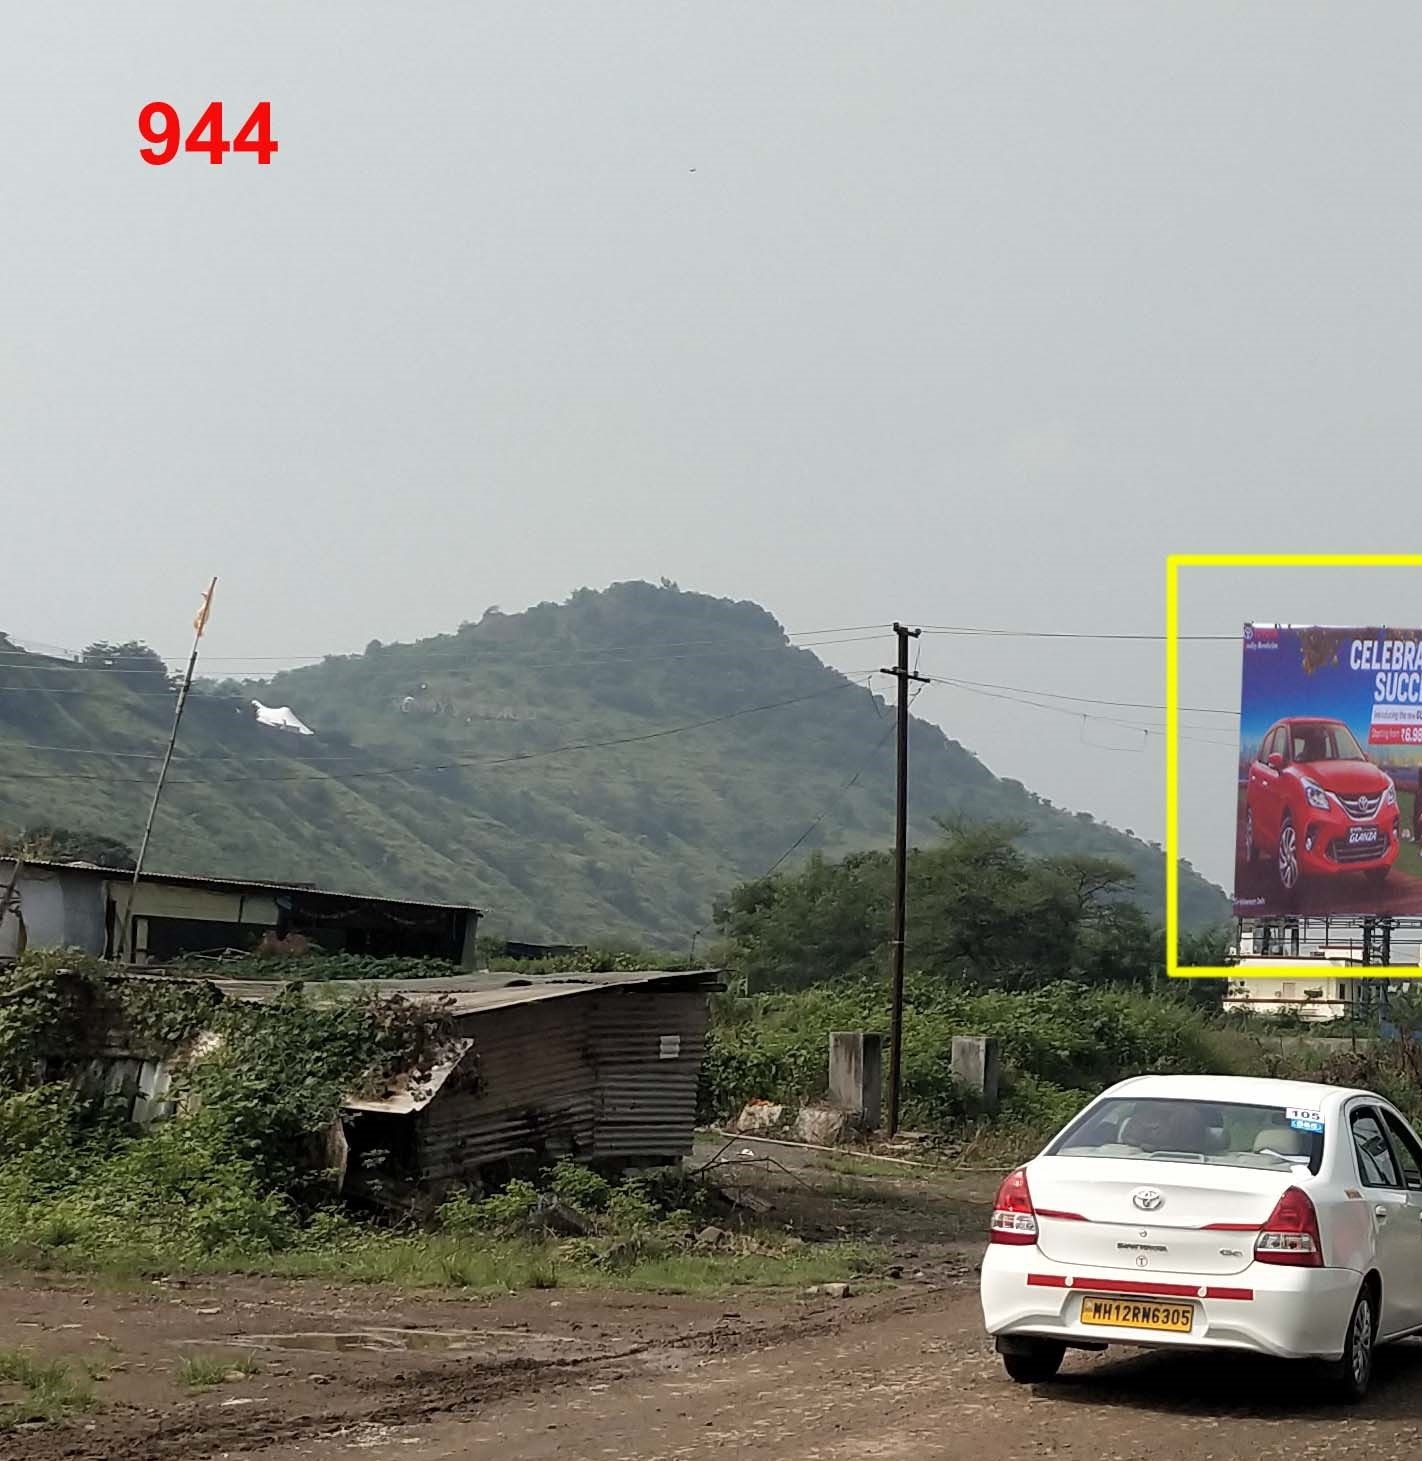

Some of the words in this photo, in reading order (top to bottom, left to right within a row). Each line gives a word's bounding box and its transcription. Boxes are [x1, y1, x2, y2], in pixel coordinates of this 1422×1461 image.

[1349, 831, 1377, 843] GLANZA
[1292, 1110, 1320, 1120] 105
[1092, 1302, 1191, 1326] MH12RN6305
